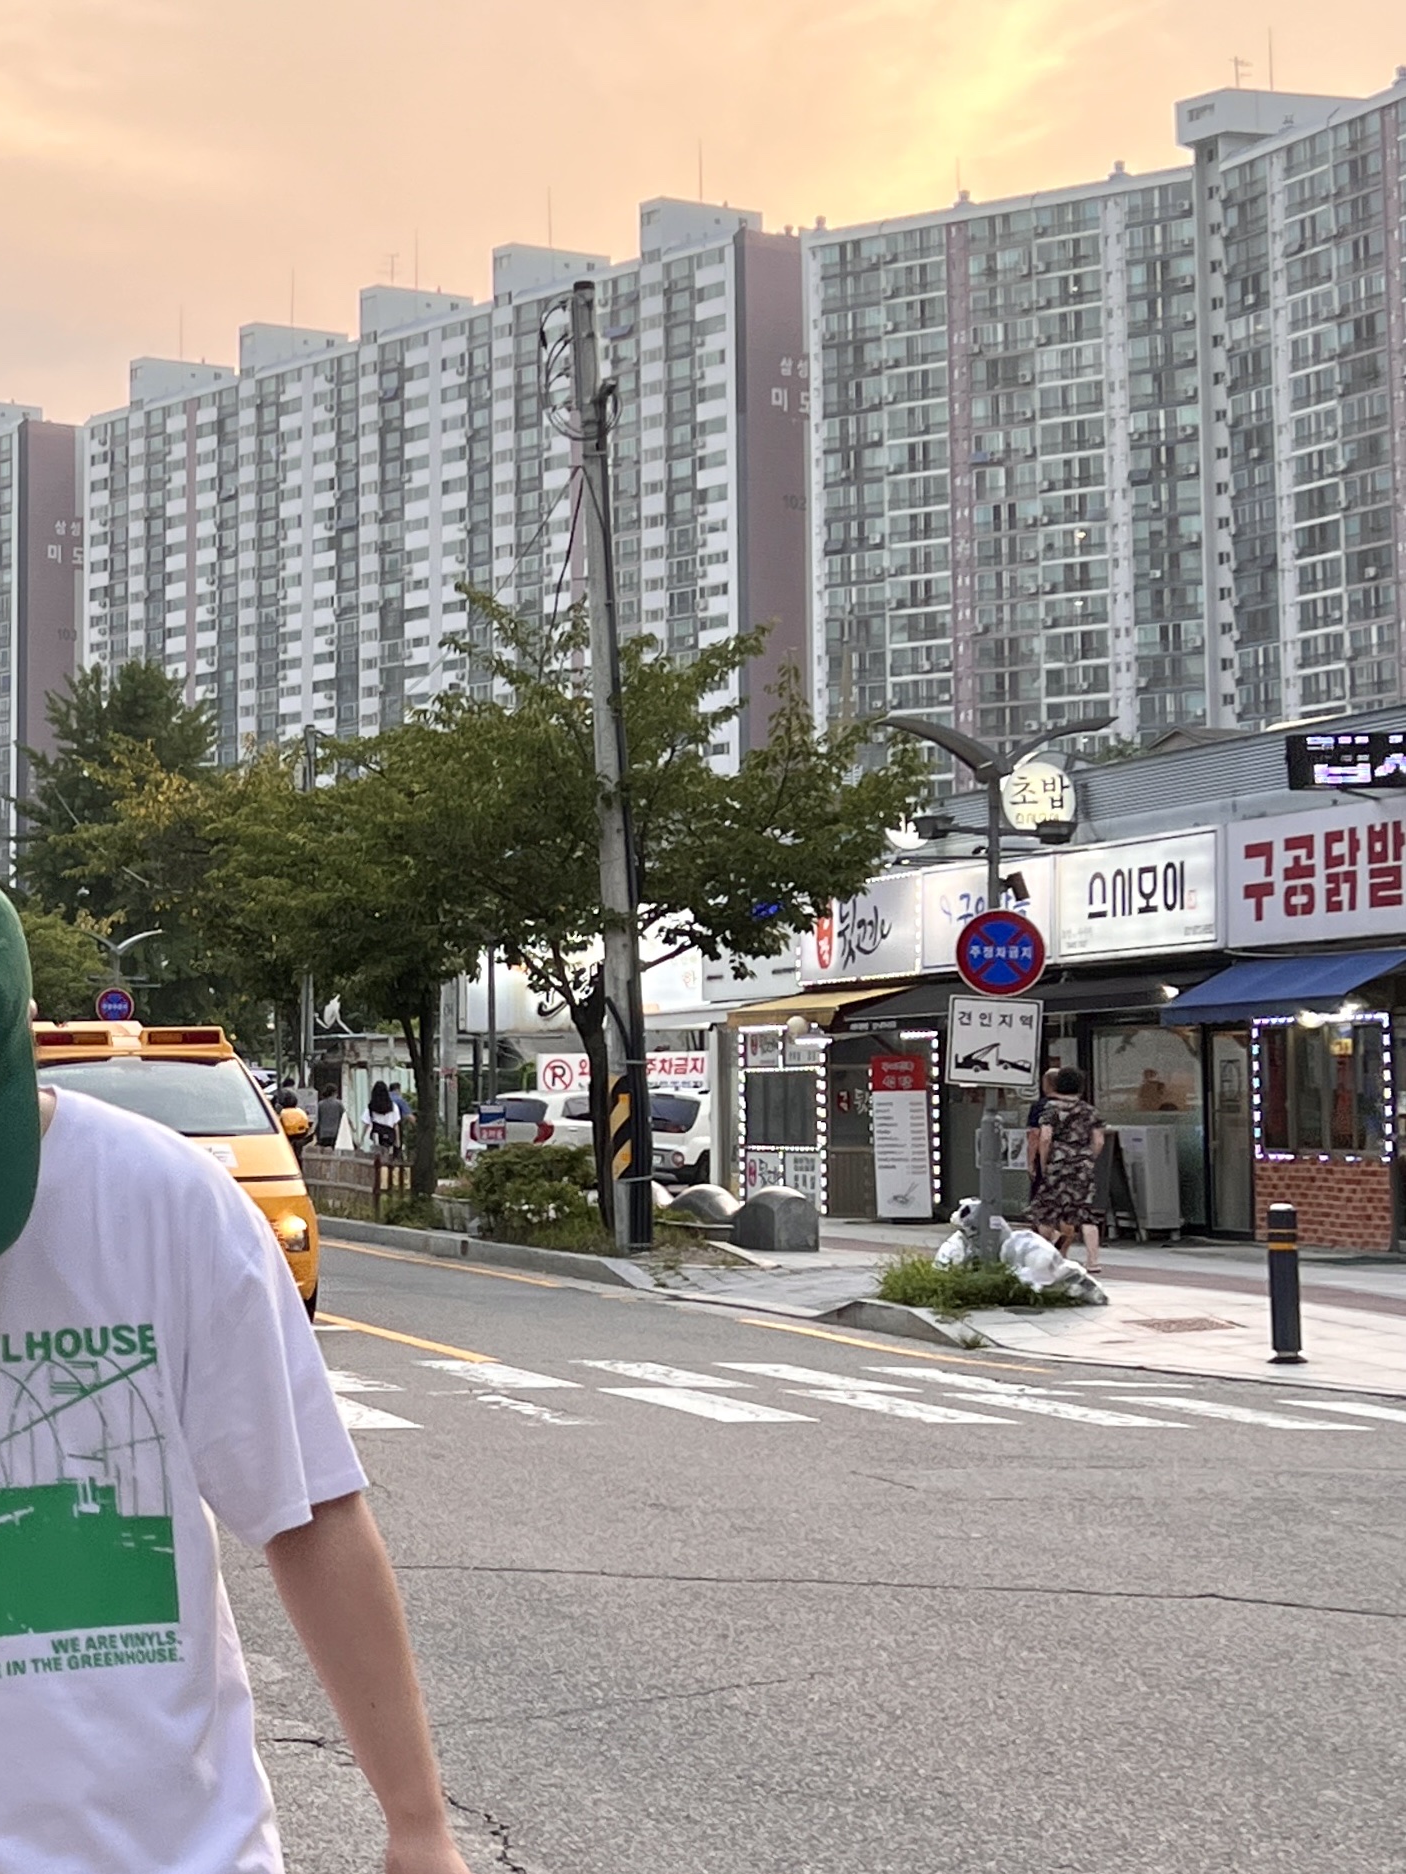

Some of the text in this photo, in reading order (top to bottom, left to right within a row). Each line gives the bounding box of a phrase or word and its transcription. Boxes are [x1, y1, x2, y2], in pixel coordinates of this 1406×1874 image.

[1009, 773, 1070, 810] 초밥
[1243, 820, 1406, 922] 구공닭발
[1088, 860, 1185, 920] 스시모이
[969, 944, 1033, 960] 주정차금지
[958, 1011, 1034, 1030] 견인지역
[50, 1630, 183, 1655] WE ARE VINYLS.
[6, 1659, 27, 1676] IN
[31, 1655, 64, 1674] THE
[67, 1647, 186, 1671] GREENHOUSE.
